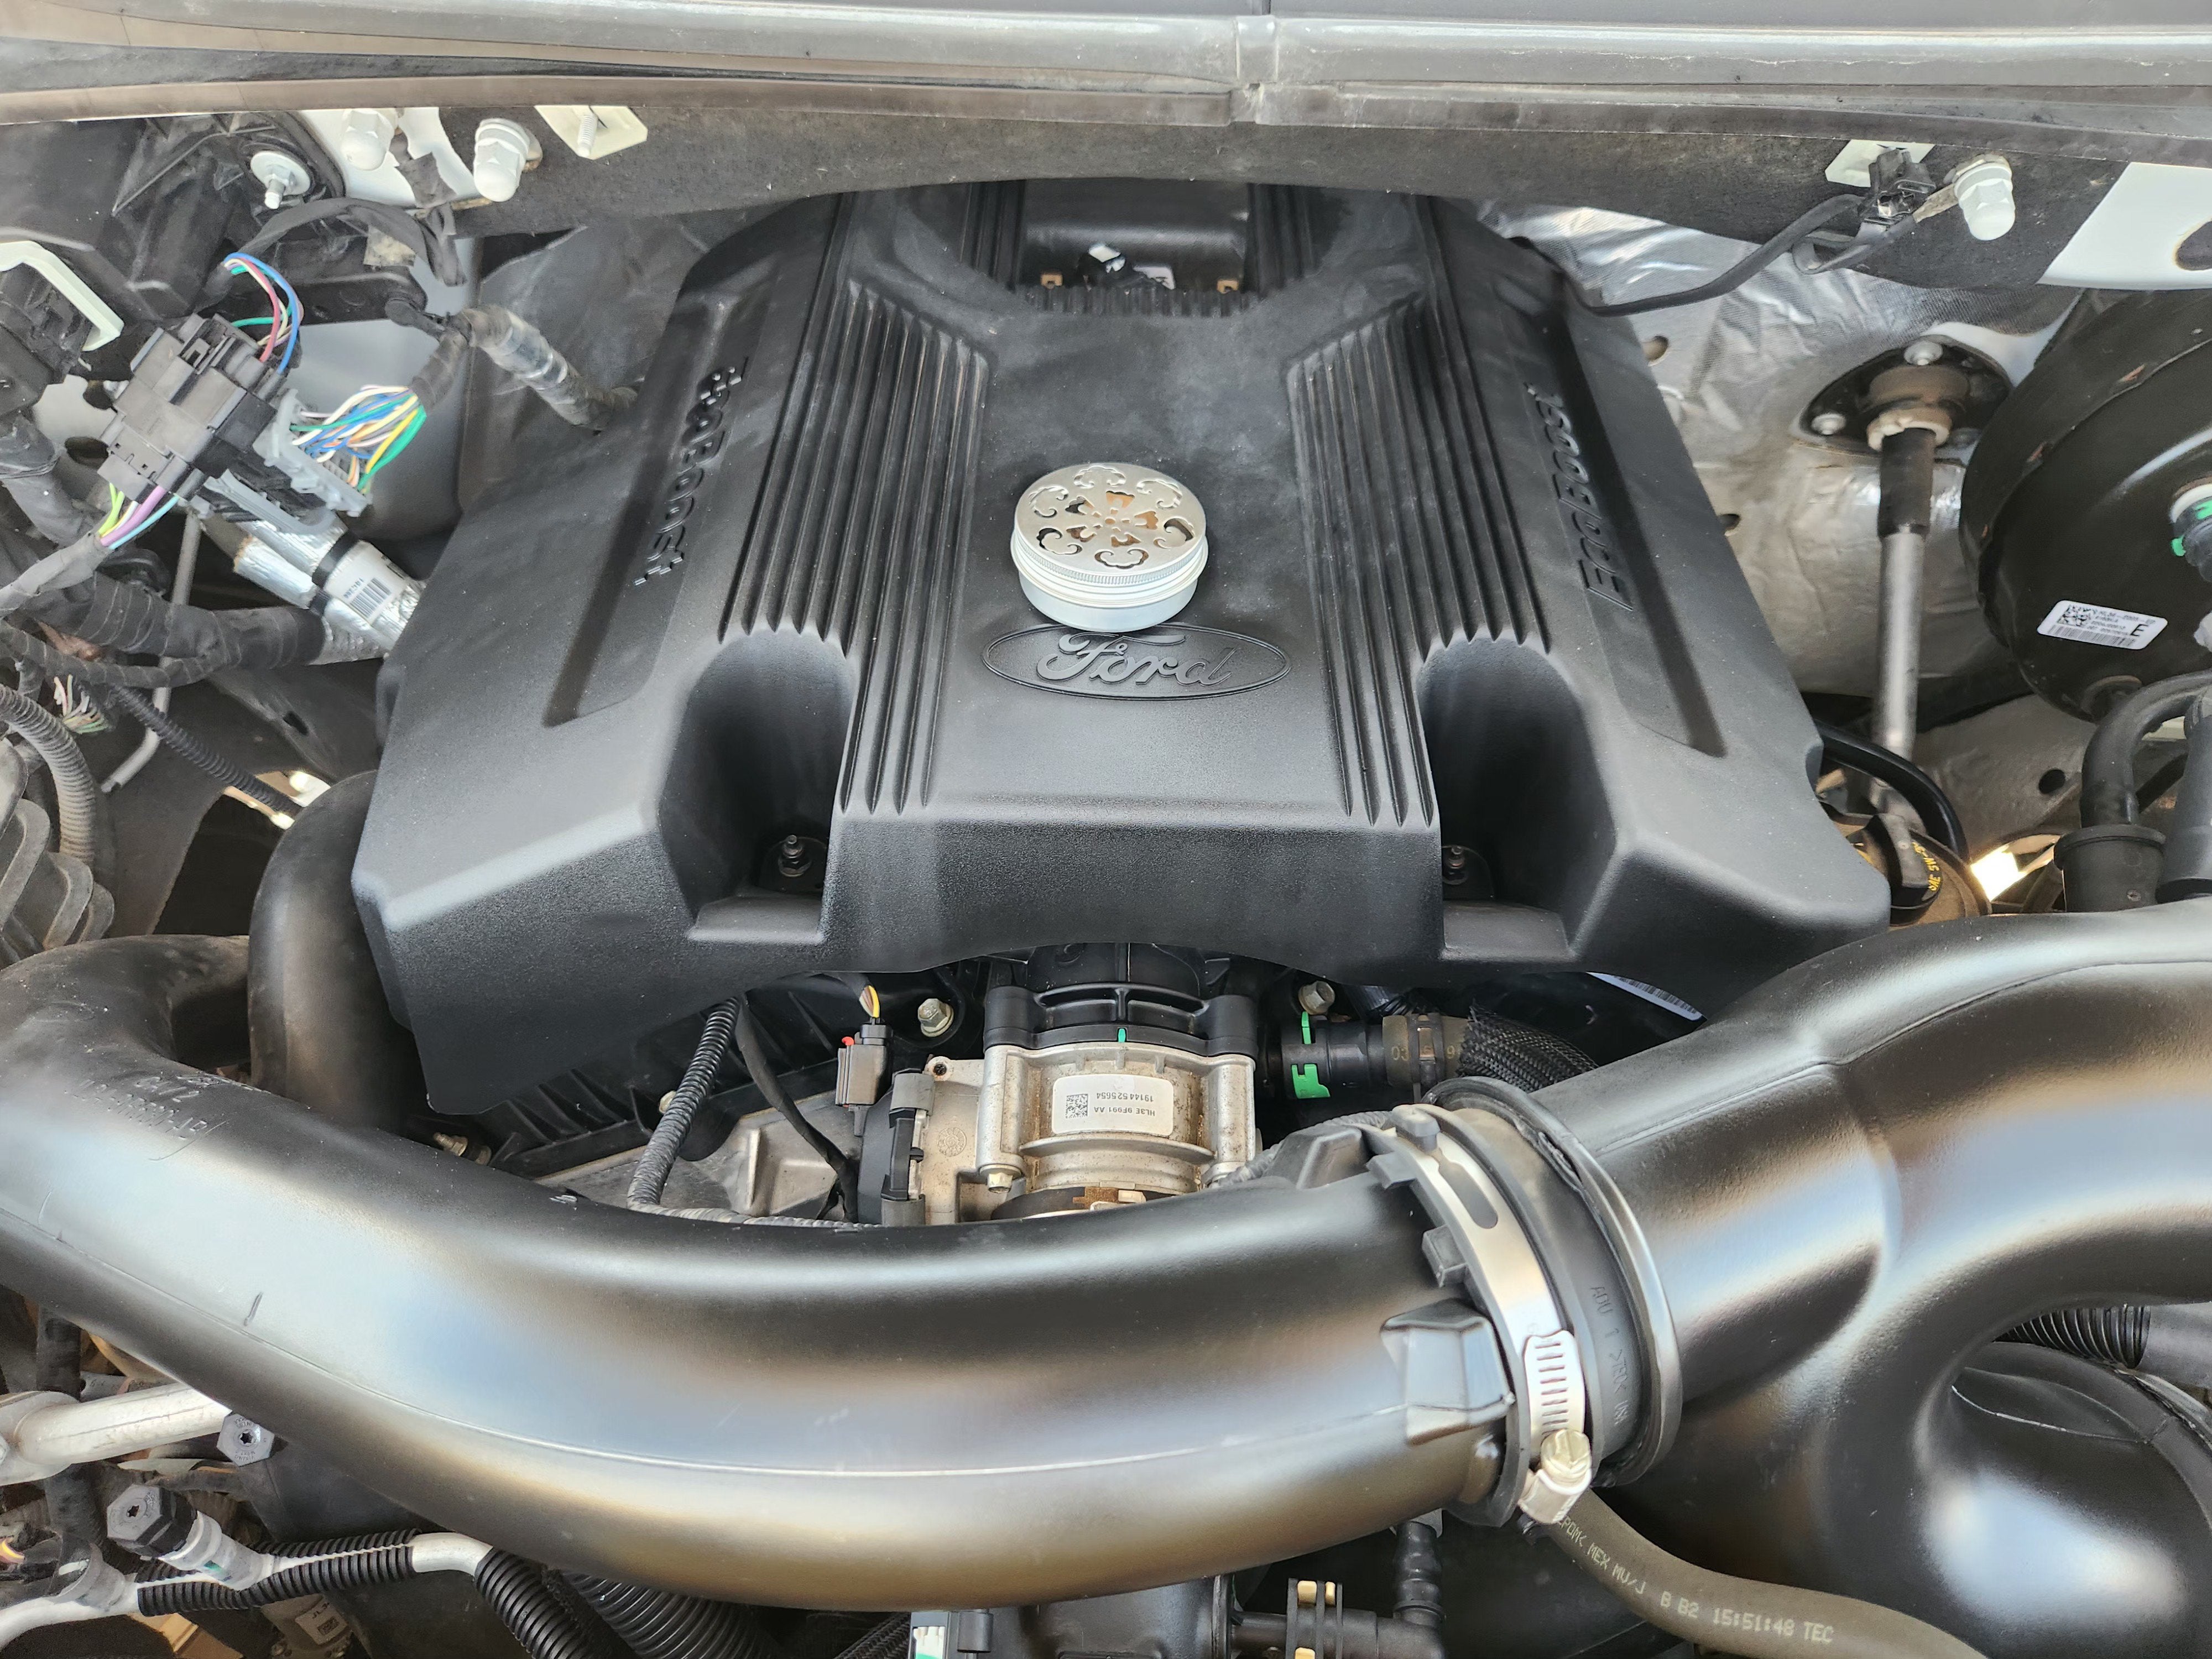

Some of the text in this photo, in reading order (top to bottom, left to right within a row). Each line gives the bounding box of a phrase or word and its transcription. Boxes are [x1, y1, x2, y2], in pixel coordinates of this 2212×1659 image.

[2131, 624, 2148, 637] E
[1036, 631, 1235, 687] Ford
[1927, 874, 1940, 891] SAE
[1136, 1108, 1155, 1116] HL3E
[1558, 1515, 1585, 1548] PDM<
[1587, 1542, 1610, 1571] MEX
[1713, 1608, 1795, 1636] 15:51:48
[1803, 1621, 1834, 1644] TEC
